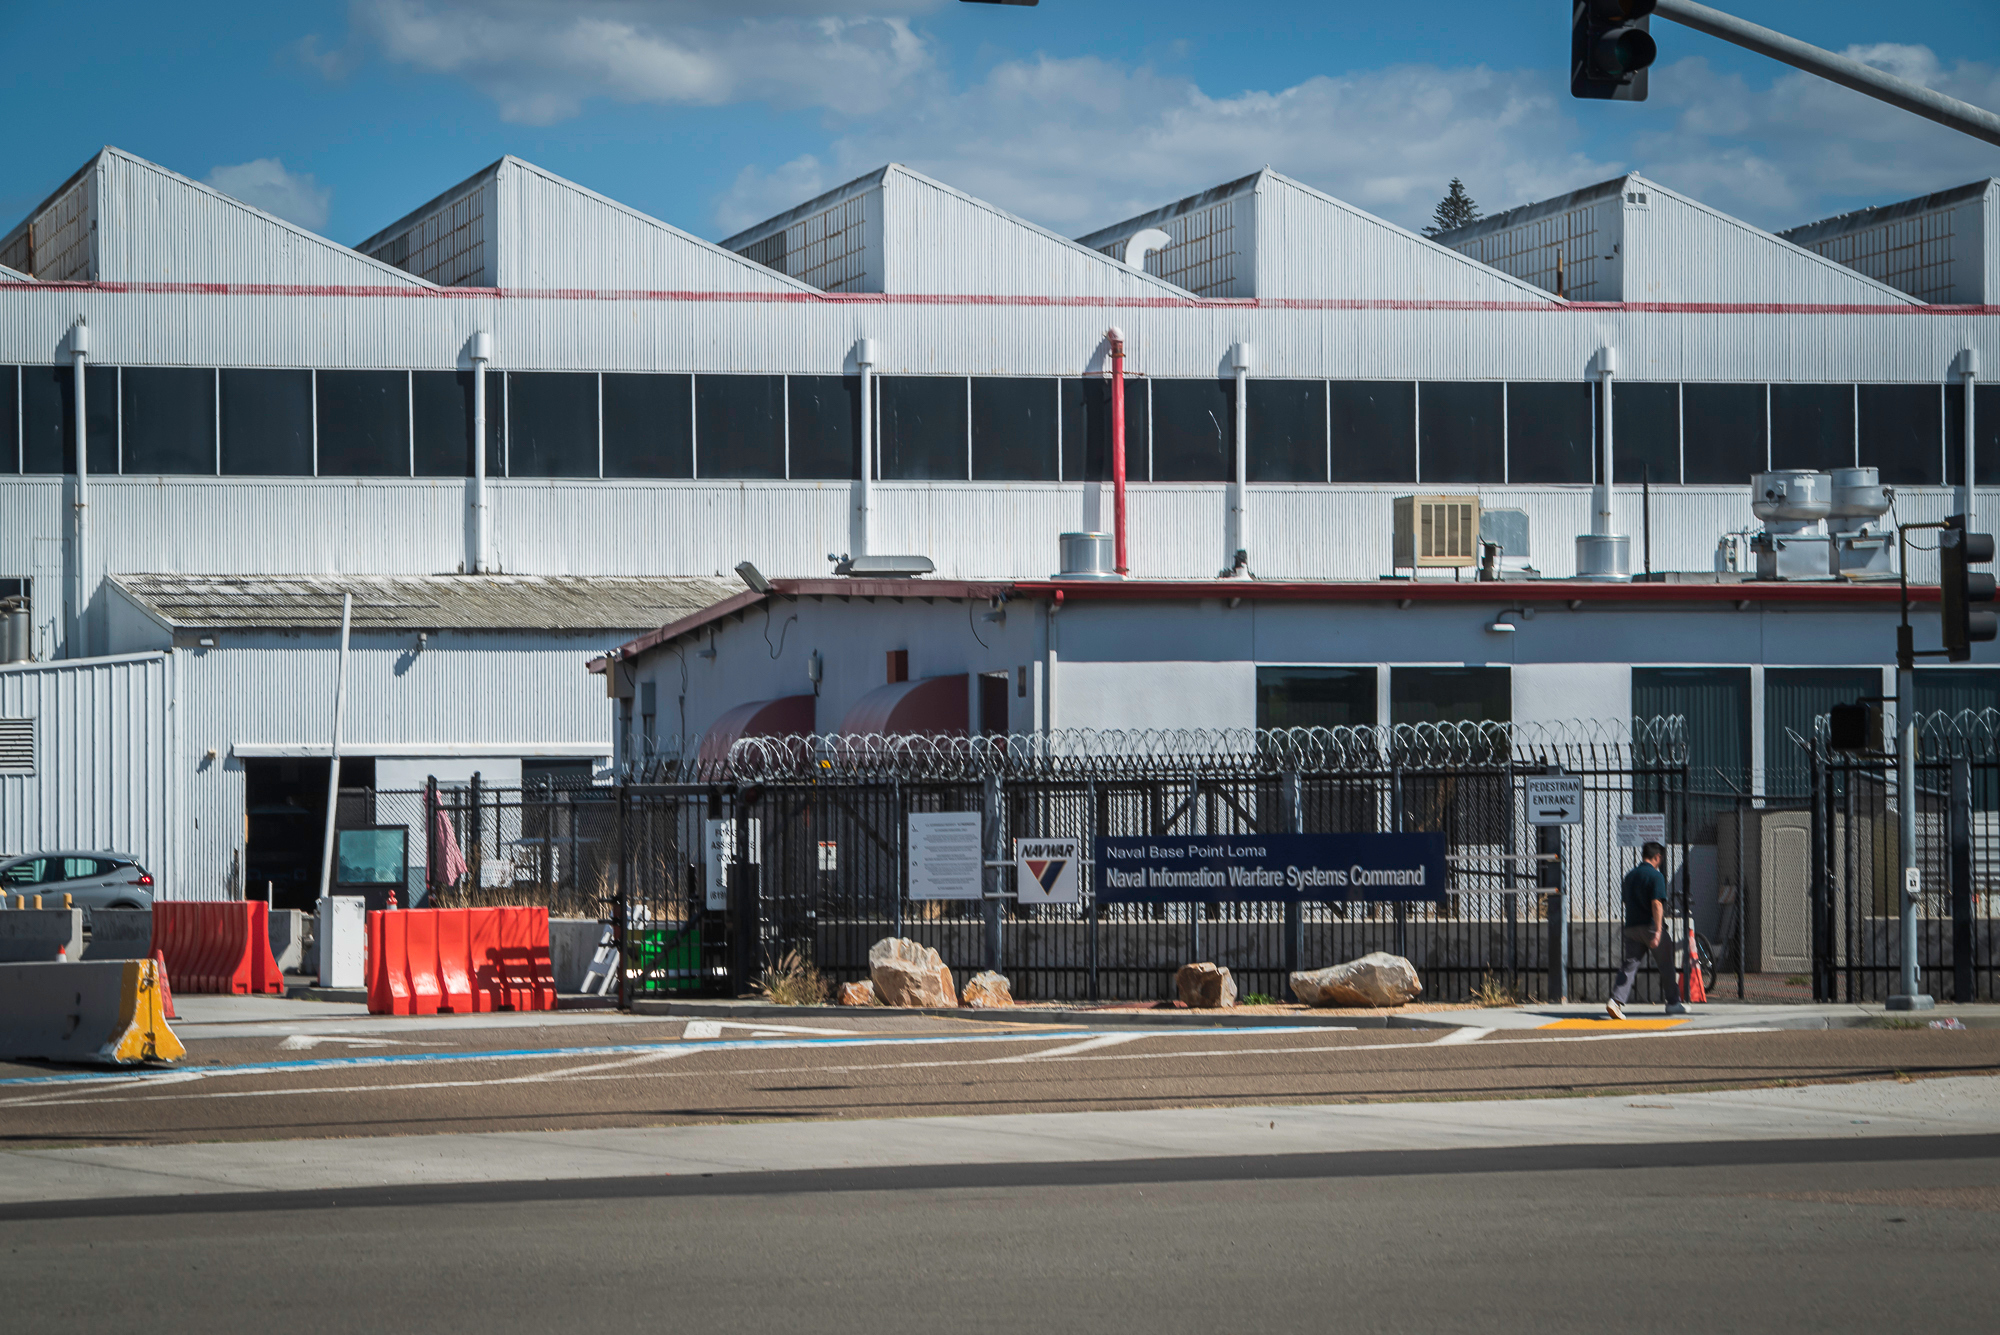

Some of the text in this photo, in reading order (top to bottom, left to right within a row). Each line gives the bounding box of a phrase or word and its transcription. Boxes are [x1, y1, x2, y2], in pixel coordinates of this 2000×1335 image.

[1530, 781, 1579, 792] PEDESTRIAN
[1533, 795, 1576, 805] ENTRANCE
[1021, 844, 1075, 858] NAVWAR
[1106, 844, 1267, 859] Naval Base Point Loma
[1106, 864, 1426, 892] Naval Information Warfare Systems Command
